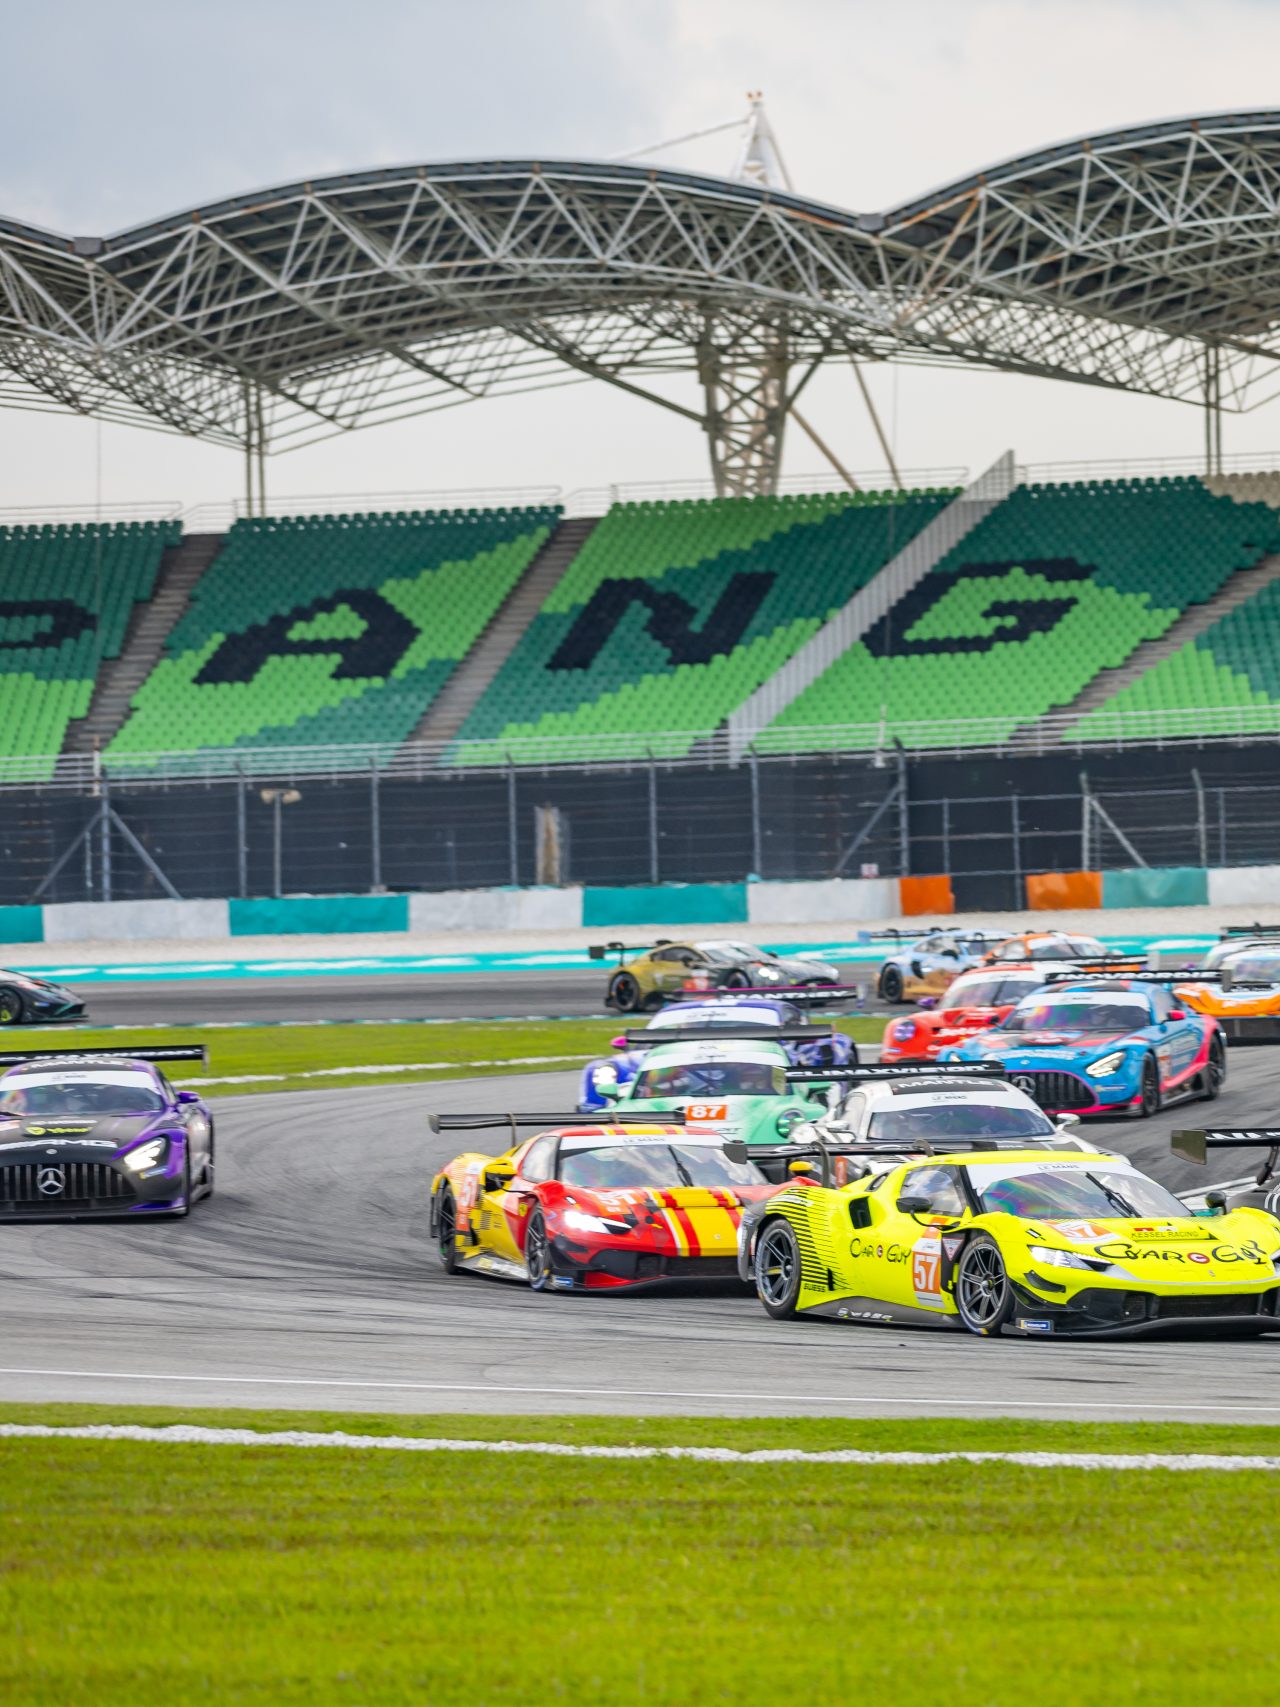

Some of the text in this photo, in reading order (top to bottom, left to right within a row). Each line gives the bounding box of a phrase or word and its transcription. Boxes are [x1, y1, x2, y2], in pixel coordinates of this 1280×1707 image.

[898, 1079, 995, 1088] MANTLE
[691, 1105, 723, 1118] 87
[1131, 1229, 1199, 1239] KESSEL RACING
[886, 1244, 912, 1264] GUY
[914, 1254, 939, 1291] 57
[803, 1283, 826, 1293] GUESS
